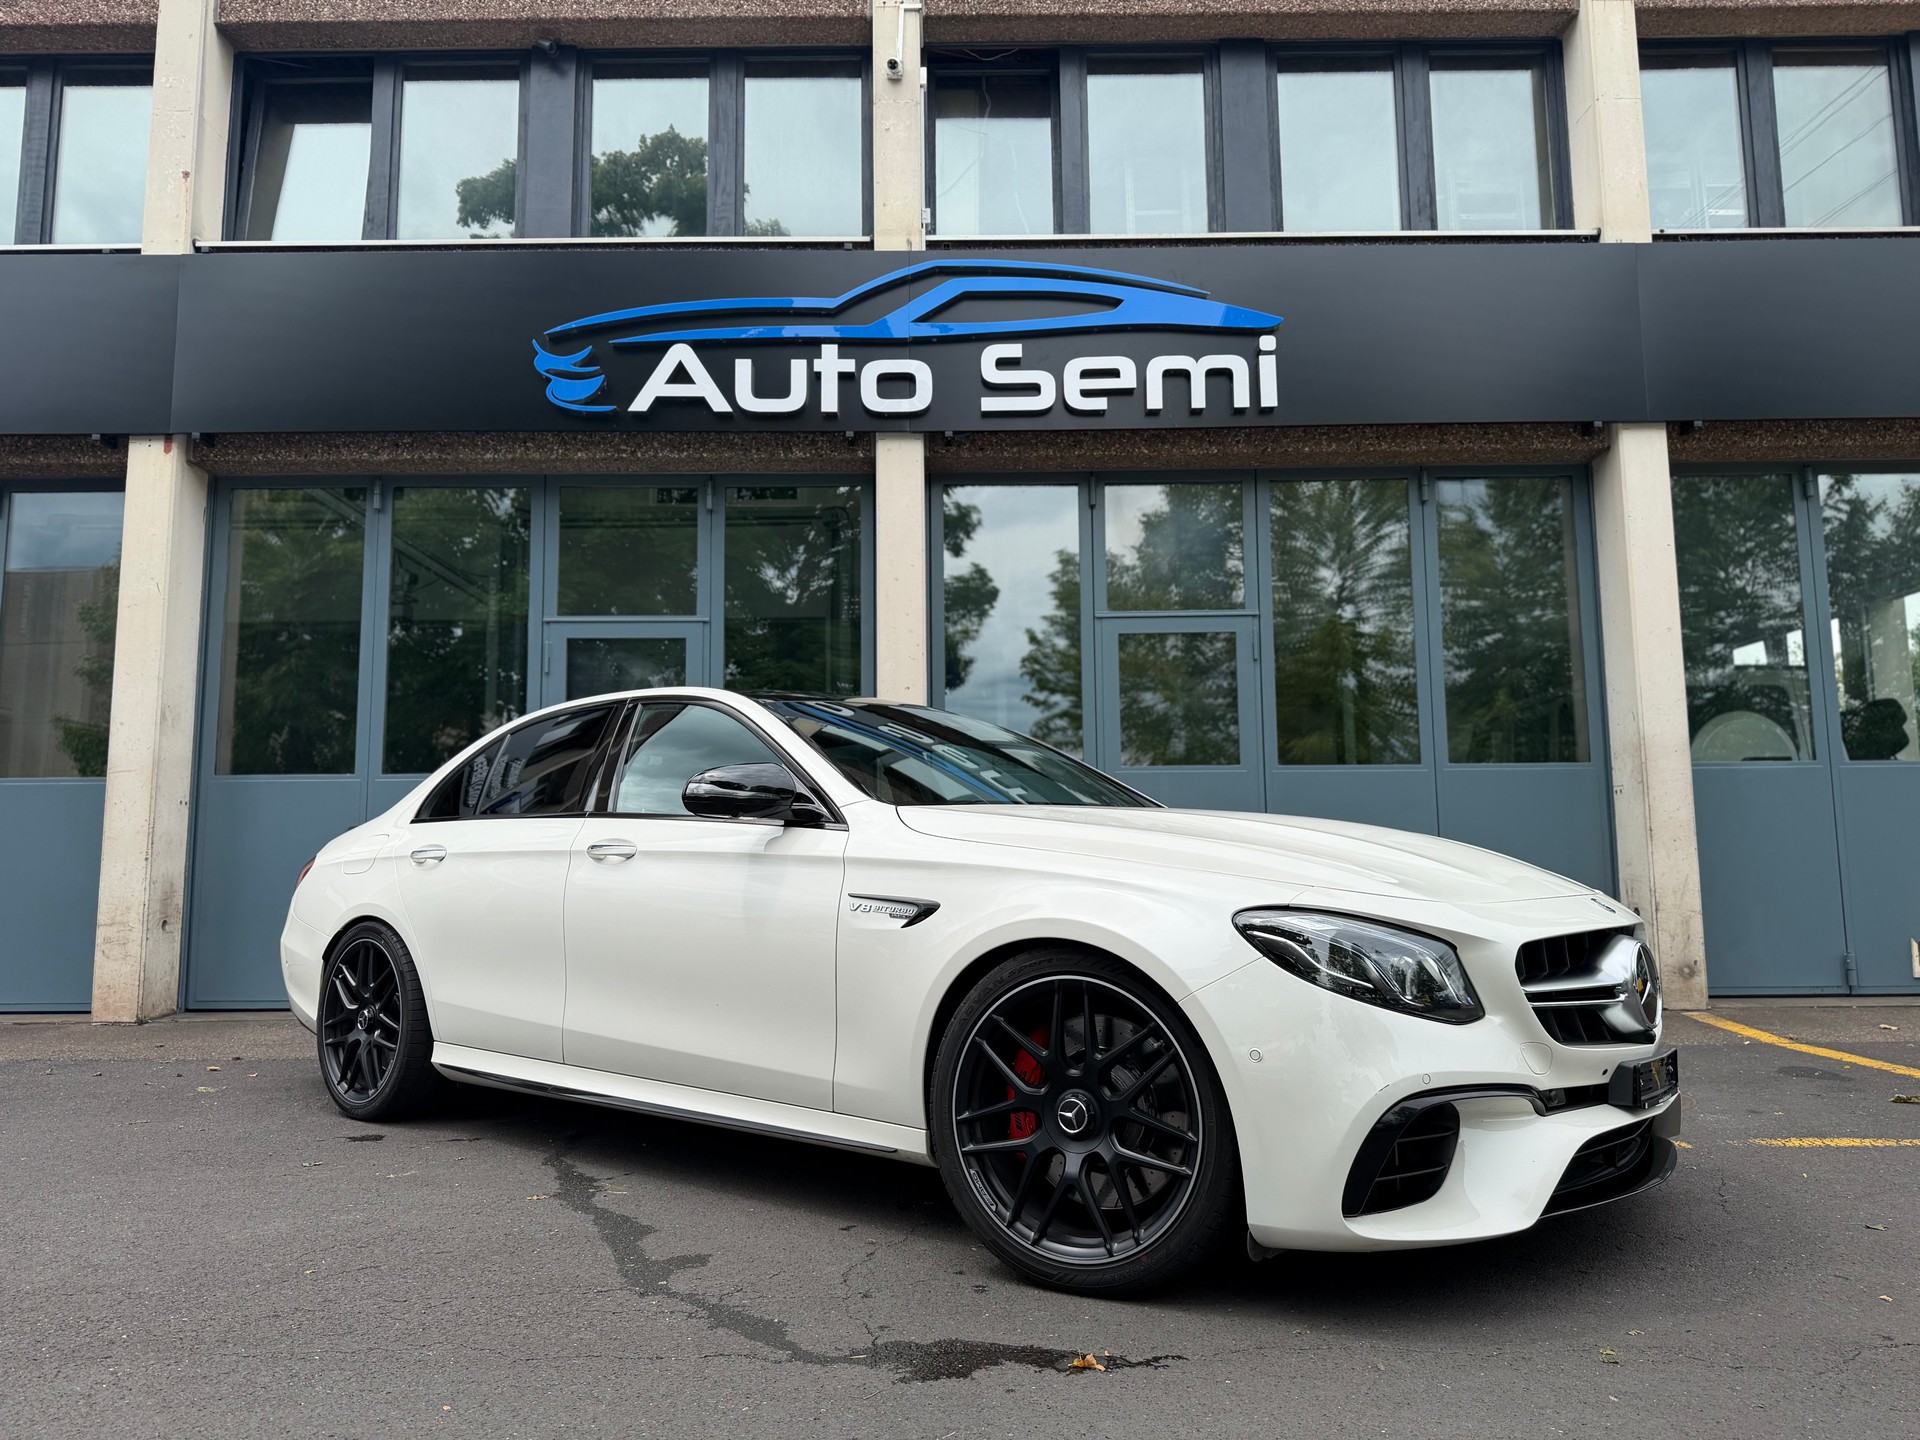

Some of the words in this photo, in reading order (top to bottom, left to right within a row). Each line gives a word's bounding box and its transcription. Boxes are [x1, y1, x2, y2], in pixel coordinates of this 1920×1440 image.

[628, 343, 933, 413] Auto
[980, 336, 1278, 411] Semi
[849, 902, 872, 913] V8
[872, 904, 915, 914] BITURBO
